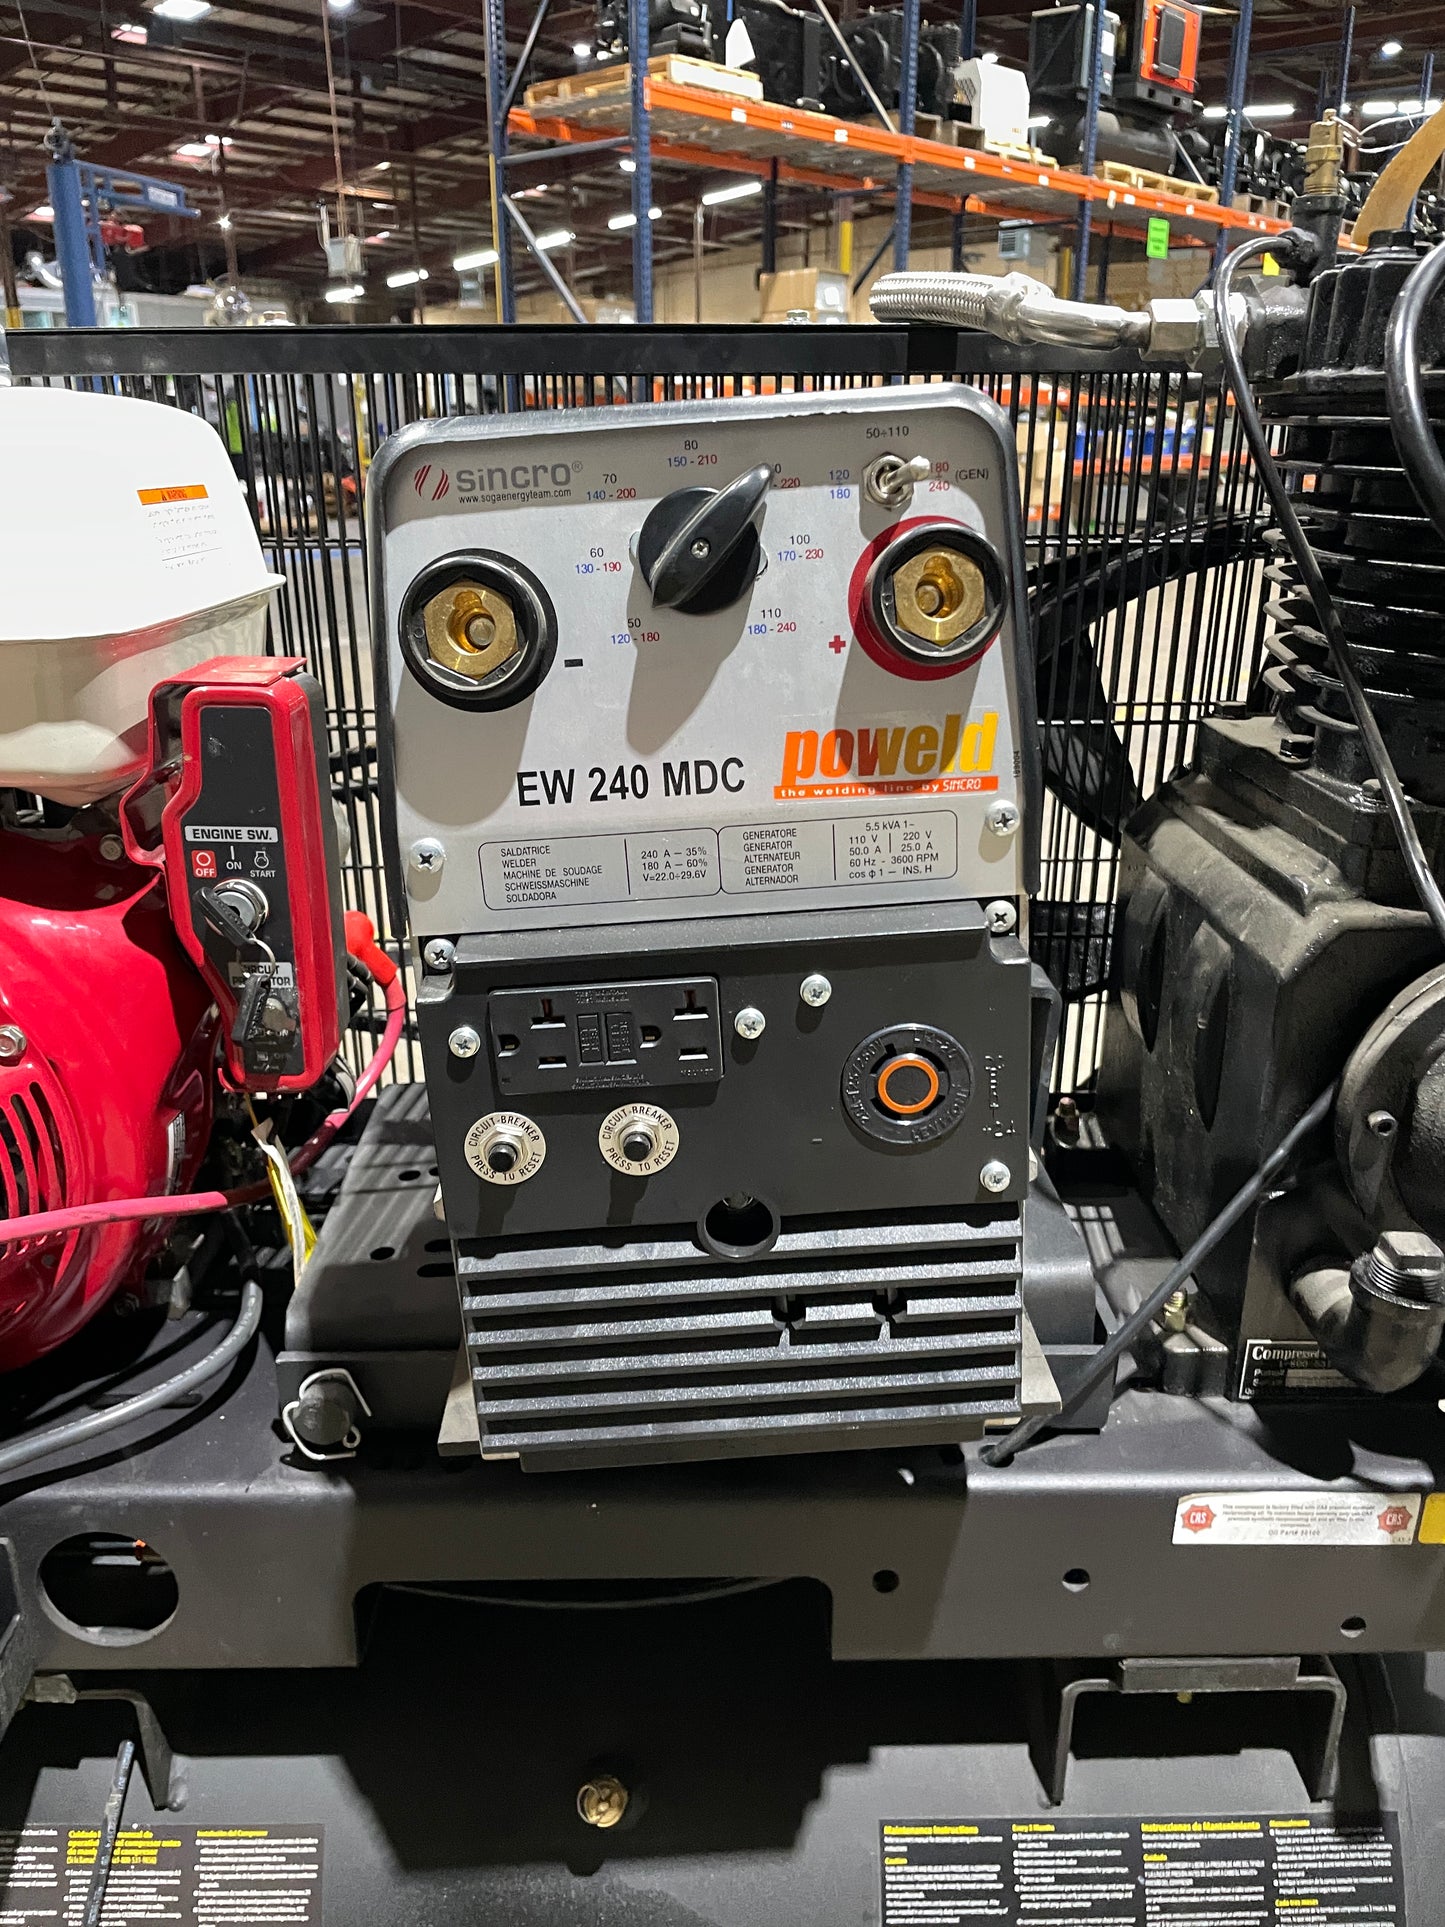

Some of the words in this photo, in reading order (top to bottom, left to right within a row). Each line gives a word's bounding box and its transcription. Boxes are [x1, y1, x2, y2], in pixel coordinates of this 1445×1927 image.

[684, 440, 698, 450] 80
[668, 456, 687, 467] 150
[697, 454, 718, 465] 210
[929, 462, 949, 473] 180
[602, 474, 617, 484] 70
[829, 469, 849, 480] 120
[955, 468, 989, 483] (GEN)
[781, 477, 800, 489] 220
[929, 481, 950, 492] 240
[459, 489, 571, 504] www.sogaenergyteam.com
[587, 489, 606, 500] 140
[616, 488, 637, 499] 200
[829, 489, 850, 499] 180
[790, 535, 810, 545] 100
[590, 548, 604, 558] 60
[777, 551, 796, 562] 170
[805, 549, 824, 560] 230
[576, 564, 594, 574] 130
[603, 562, 621, 572] 190
[761, 608, 781, 619] 110
[627, 618, 641, 628] 50
[748, 624, 766, 635] 180
[777, 622, 797, 633] 240
[611, 633, 630, 644] 120
[641, 631, 660, 643] 180
[781, 712, 999, 786] poweld
[516, 771, 575, 807] EW
[588, 764, 649, 802] 240
[662, 757, 745, 797] MDC
[780, 789, 806, 798] the
[814, 786, 876, 797] welding
[883, 783, 914, 793] line
[922, 783, 940, 794] by
[942, 778, 982, 792] SINCRO
[865, 822, 880, 832] 5.5
[882, 820, 901, 830] kVA
[192, 828, 243, 840] ENGINE
[247, 829, 272, 841] SW.
[742, 828, 797, 841] GENERATORE
[849, 835, 866, 845] 110
[871, 834, 879, 843] V
[902, 831, 920, 841] 220
[925, 830, 933, 839] V
[501, 845, 551, 857] SALDATRICE
[743, 841, 793, 852] GENERATOR
[849, 846, 869, 856] 50.0
[874, 845, 882, 854] A
[900, 842, 921, 852] 25.0
[925, 841, 934, 850] A
[641, 850, 658, 860] 240
[663, 849, 671, 858] A
[685, 846, 708, 857] 35%
[744, 851, 801, 864] ALTERNATEUR
[226, 861, 243, 870] ON
[502, 858, 537, 868] WELDER
[642, 861, 659, 871] 180
[664, 860, 672, 870] A
[686, 858, 708, 868] 60%
[849, 858, 861, 868] 60
[863, 857, 877, 867] Hz
[890, 854, 915, 864] 3600
[915, 852, 939, 863] RPM
[195, 868, 215, 877] OFF
[249, 869, 276, 878] START
[503, 870, 542, 880] MACHINE
[545, 868, 557, 878] DE
[562, 865, 603, 876] SOUDAGE
[744, 863, 794, 875] GENERATOR
[849, 870, 866, 880] cos
[878, 868, 884, 877] 1
[924, 864, 933, 873] H
[642, 870, 707, 883] V=22.0÷29.6V
[745, 875, 799, 887] ALTERNADOR
[504, 878, 590, 892] SCHWEISSMASCHINE
[506, 891, 557, 903] SOLDADORA
[605, 1146, 632, 1172] PRESS
[638, 1162, 651, 1172] TO
[654, 1139, 676, 1168] RESET
[470, 1154, 497, 1180] PRESS
[502, 1171, 515, 1182] TO
[518, 1151, 543, 1178] RESET
[1252, 1345, 1320, 1361] Compressed
[1189, 1512, 1207, 1524] CAS
[1385, 1513, 1404, 1526] CAS
